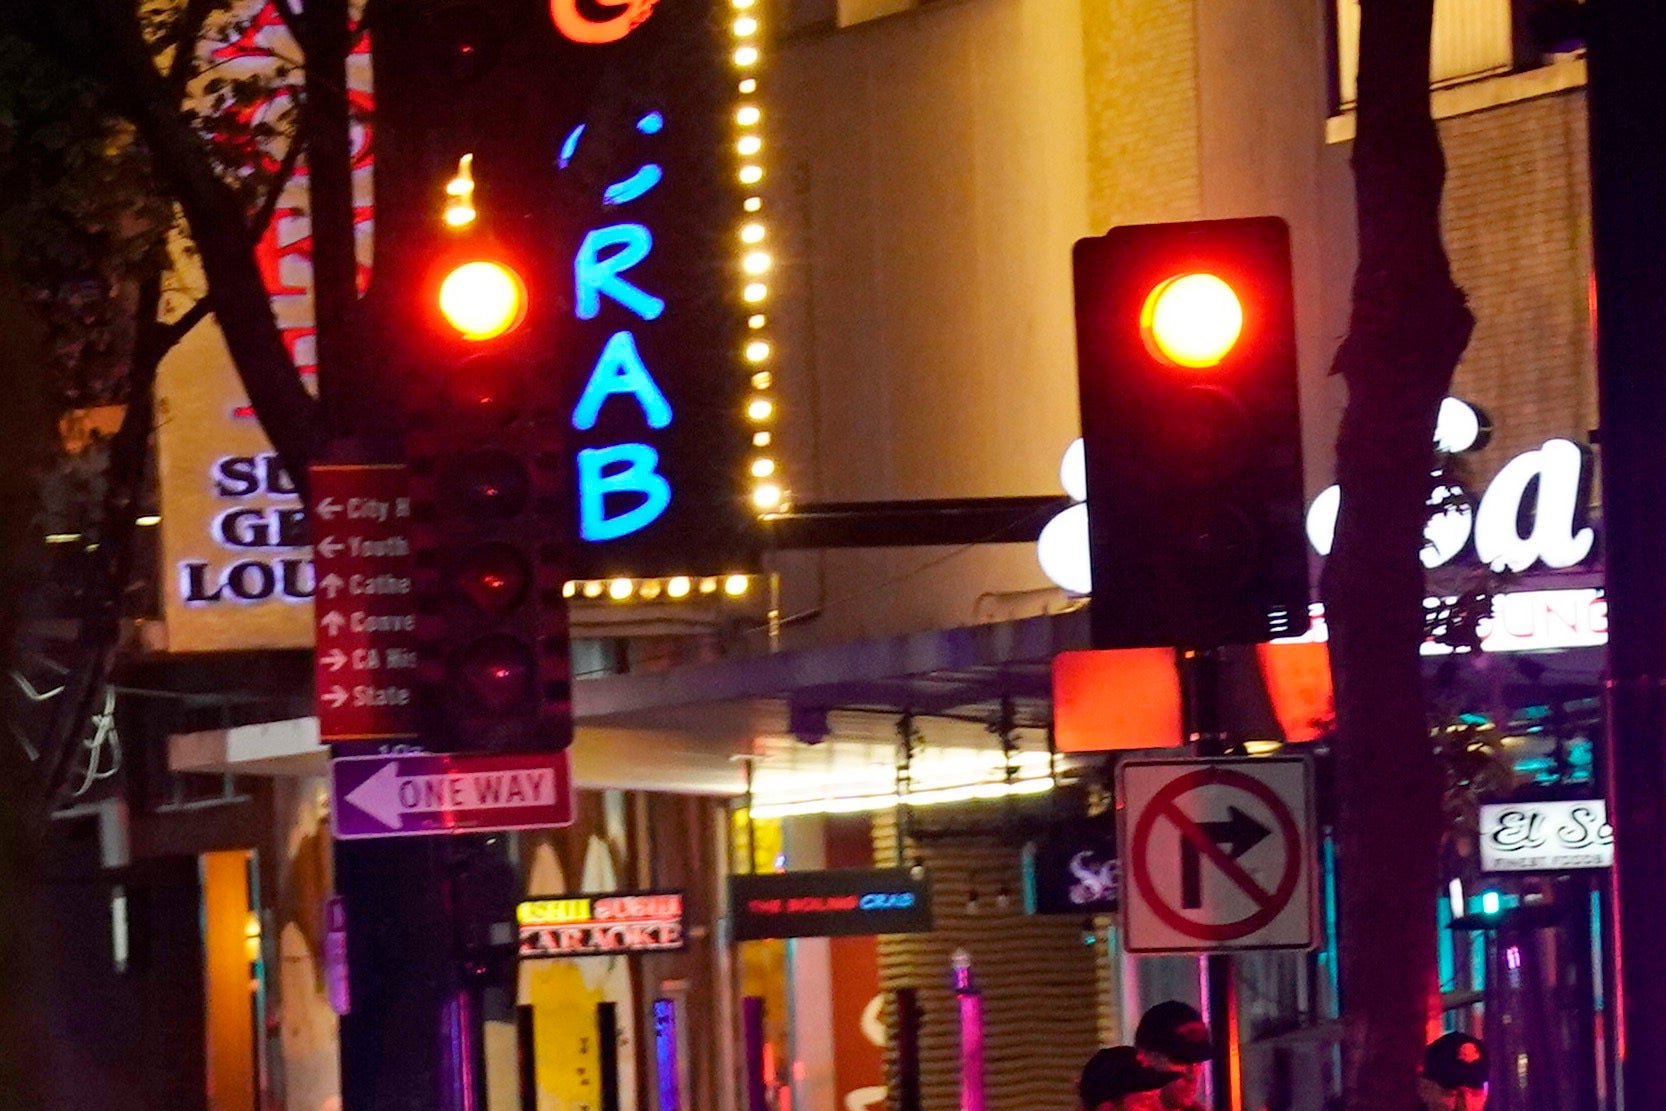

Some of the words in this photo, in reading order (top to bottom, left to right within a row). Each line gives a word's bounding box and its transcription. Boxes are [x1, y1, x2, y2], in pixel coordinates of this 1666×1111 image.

[556, 110, 673, 542] RAB
[347, 497, 389, 521] City
[399, 779, 464, 810] ONE
[474, 772, 546, 805] WAY
[1493, 811, 1545, 851] El
